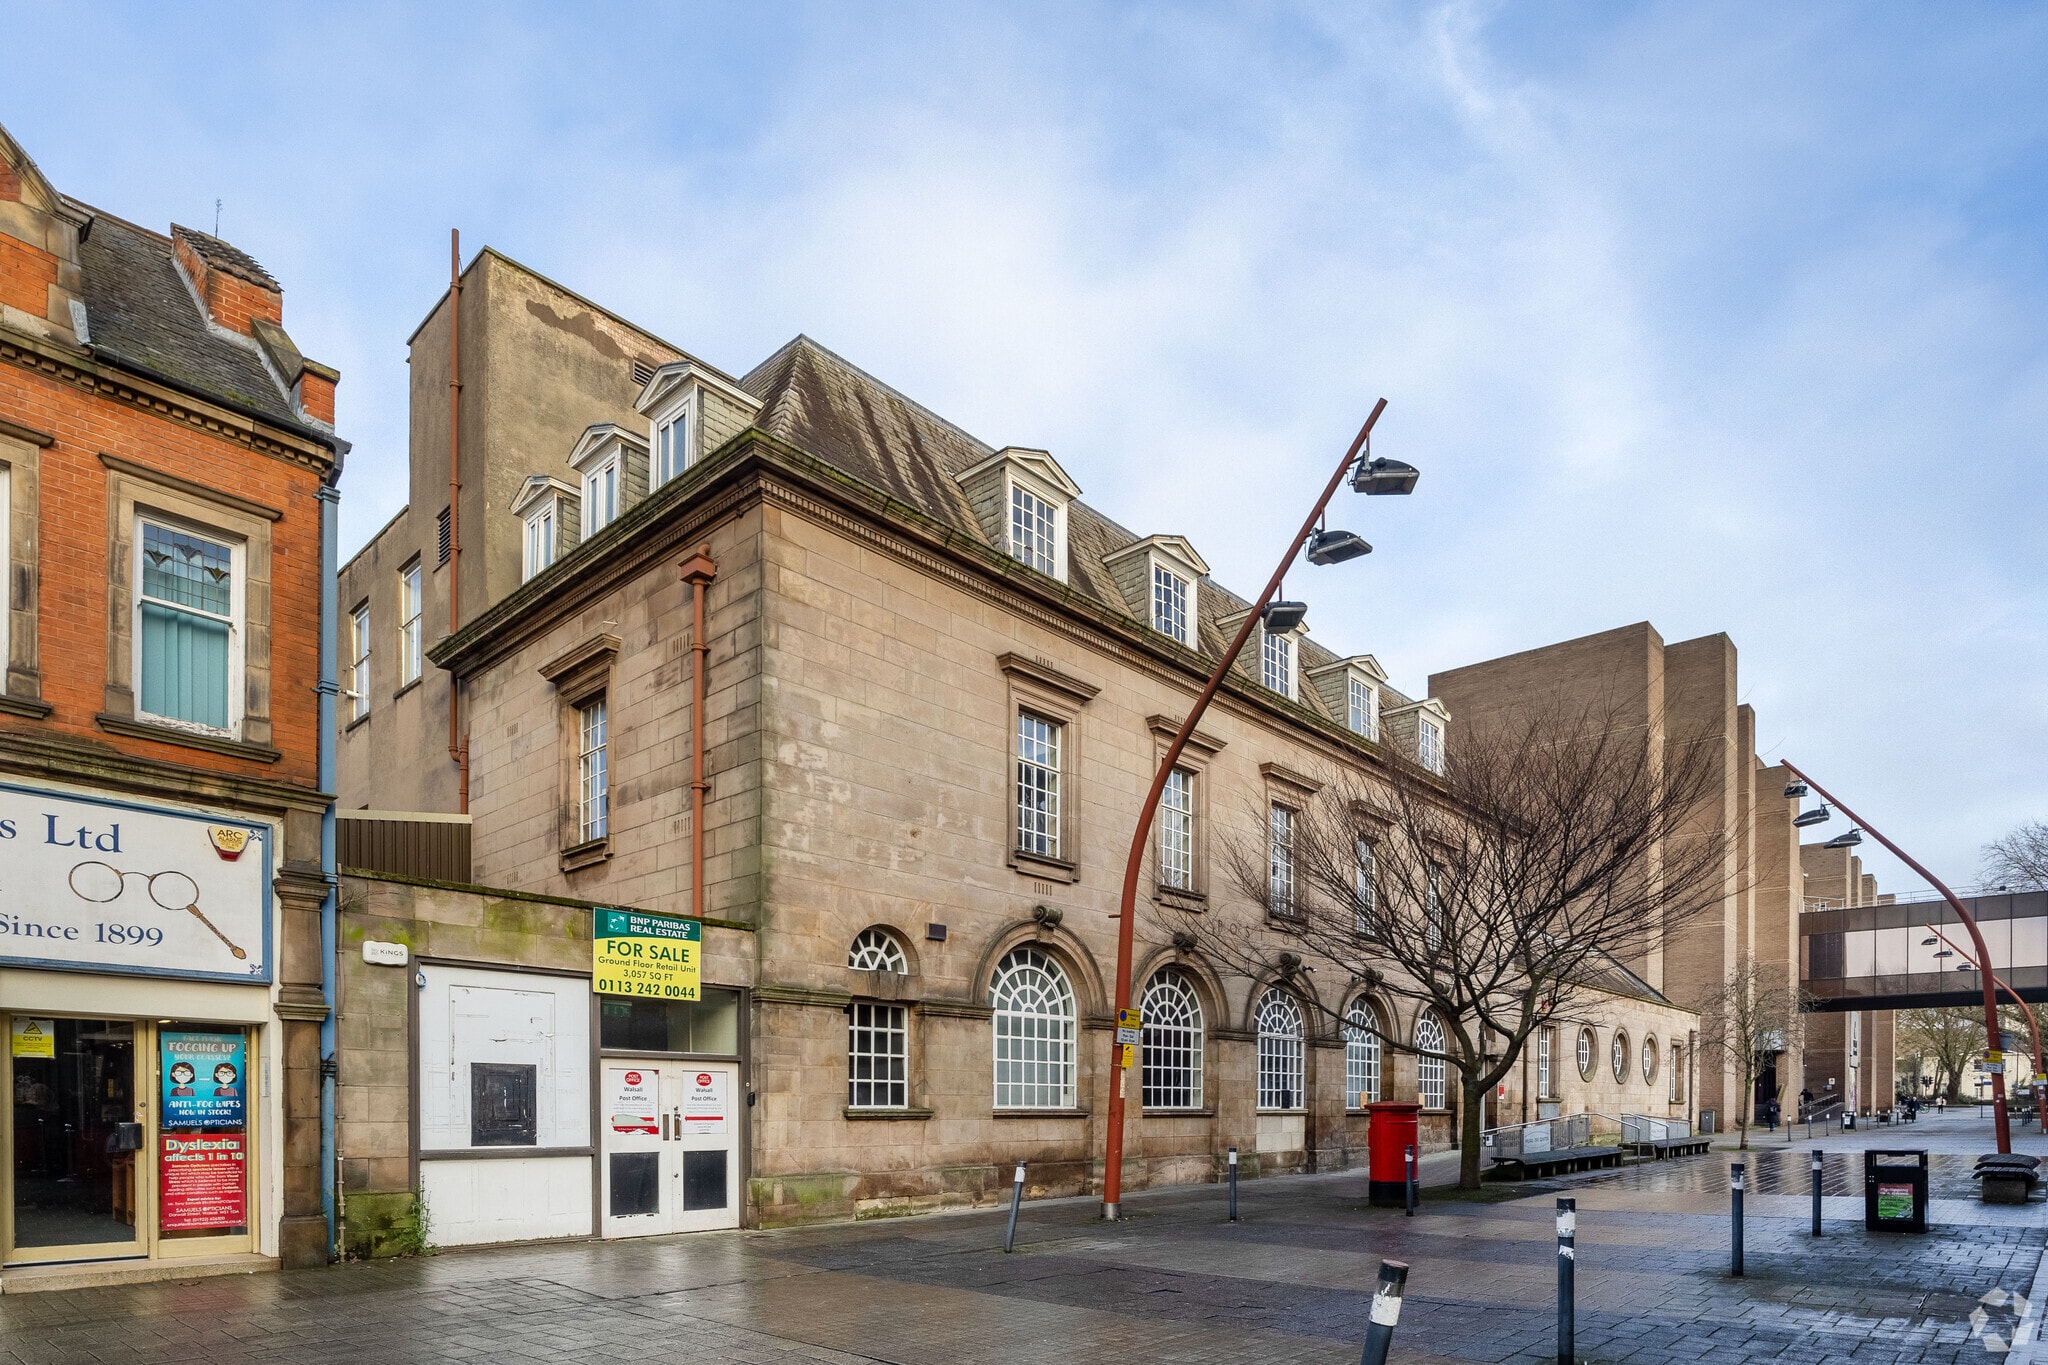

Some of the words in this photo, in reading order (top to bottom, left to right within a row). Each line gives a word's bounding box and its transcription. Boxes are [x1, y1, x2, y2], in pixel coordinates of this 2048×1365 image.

[41, 812, 124, 854] Ltd
[217, 829, 243, 840] ARC
[0, 912, 79, 941] Since
[95, 922, 164, 947] 1899
[630, 916, 650, 924] BNP
[652, 918, 690, 931] PARIBAS
[630, 925, 654, 935] REAL
[656, 928, 688, 939] ESTATE
[380, 949, 404, 957] KINGS
[607, 940, 643, 958] FOR
[650, 945, 690, 962] SALE
[598, 956, 630, 966] Ground
[633, 958, 654, 968] Floor
[656, 960, 678, 972] Retail
[680, 964, 696, 973] Unit
[624, 969, 646, 979] 3,057
[650, 972, 662, 981] SQ
[599, 978, 632, 993] 0113
[637, 982, 660, 995] 242
[665, 985, 695, 998] 0044
[168, 1042, 218, 1052] FOGGING
[221, 1043, 236, 1053] UP
[165, 1138, 240, 1153] Dyslexia
[164, 1153, 205, 1162] affects
